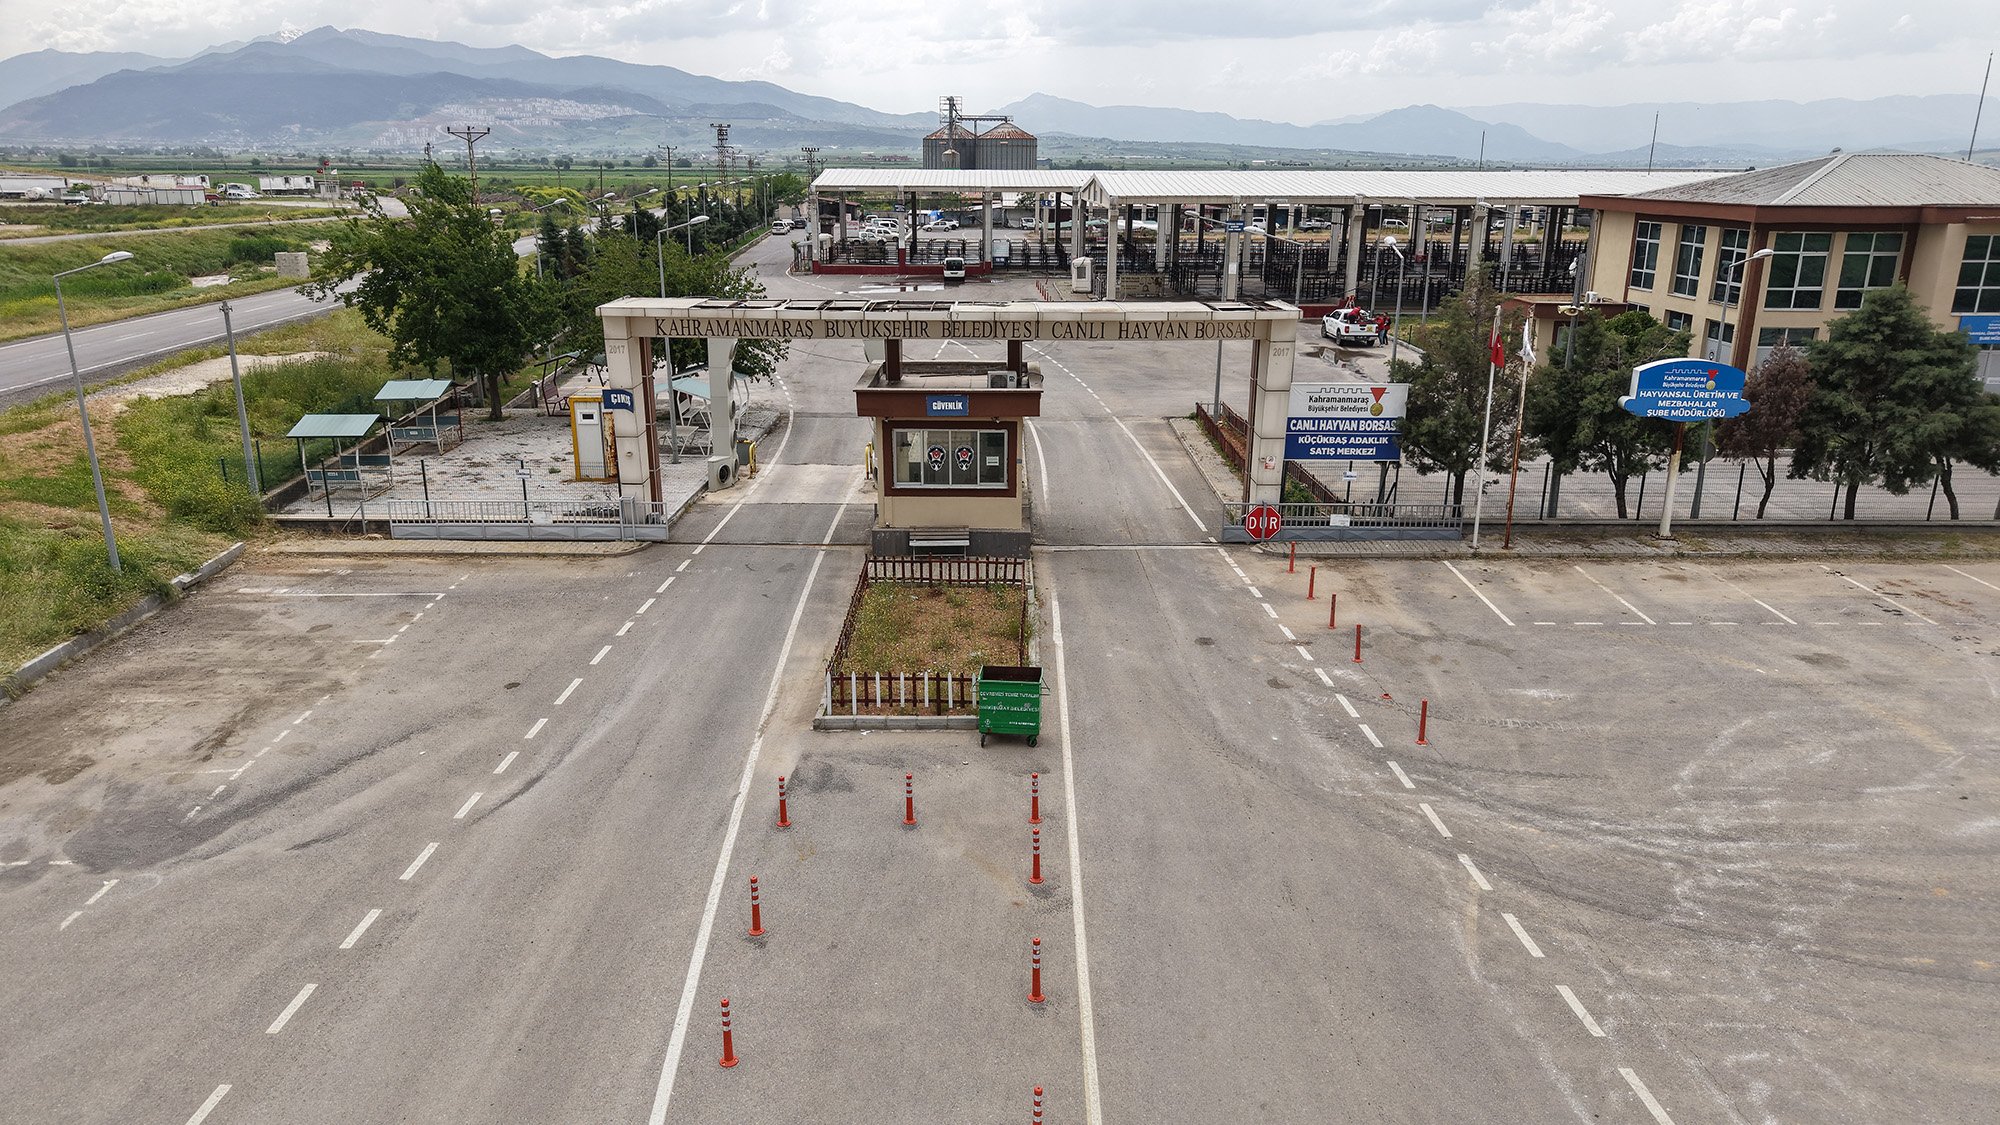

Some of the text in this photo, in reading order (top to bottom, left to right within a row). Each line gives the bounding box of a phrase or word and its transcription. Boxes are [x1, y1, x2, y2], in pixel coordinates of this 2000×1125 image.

[655, 318, 814, 339] KAHRAMANMARAŞ
[1052, 320, 1105, 339] CANLI
[1118, 320, 1188, 339] HAYVAN
[609, 345, 625, 354] 2017
[1273, 347, 1290, 357] 2017
[1640, 390, 1739, 399] HAYVANSAL ÜRETİM VE
[610, 393, 631, 407] ÇIKIŞ
[932, 400, 963, 410] GÜVENLİK
[1308, 395, 1370, 405] Kahramanmaraş
[1657, 400, 1718, 408] MEZBAHALAR
[1308, 404, 1369, 413] Büyükşehir Belediyesi
[1646, 408, 1726, 418] ŞUBE MÜDÜRLÜĞÜ
[1290, 419, 1397, 431] CANLI HAYVAN BORSAS
[1298, 435, 1389, 445] KÜÇÜKBAŞ ADAKLIK
[1309, 447, 1376, 457] SATIŞ MERKEZİ
[1248, 516, 1278, 530] DUR
